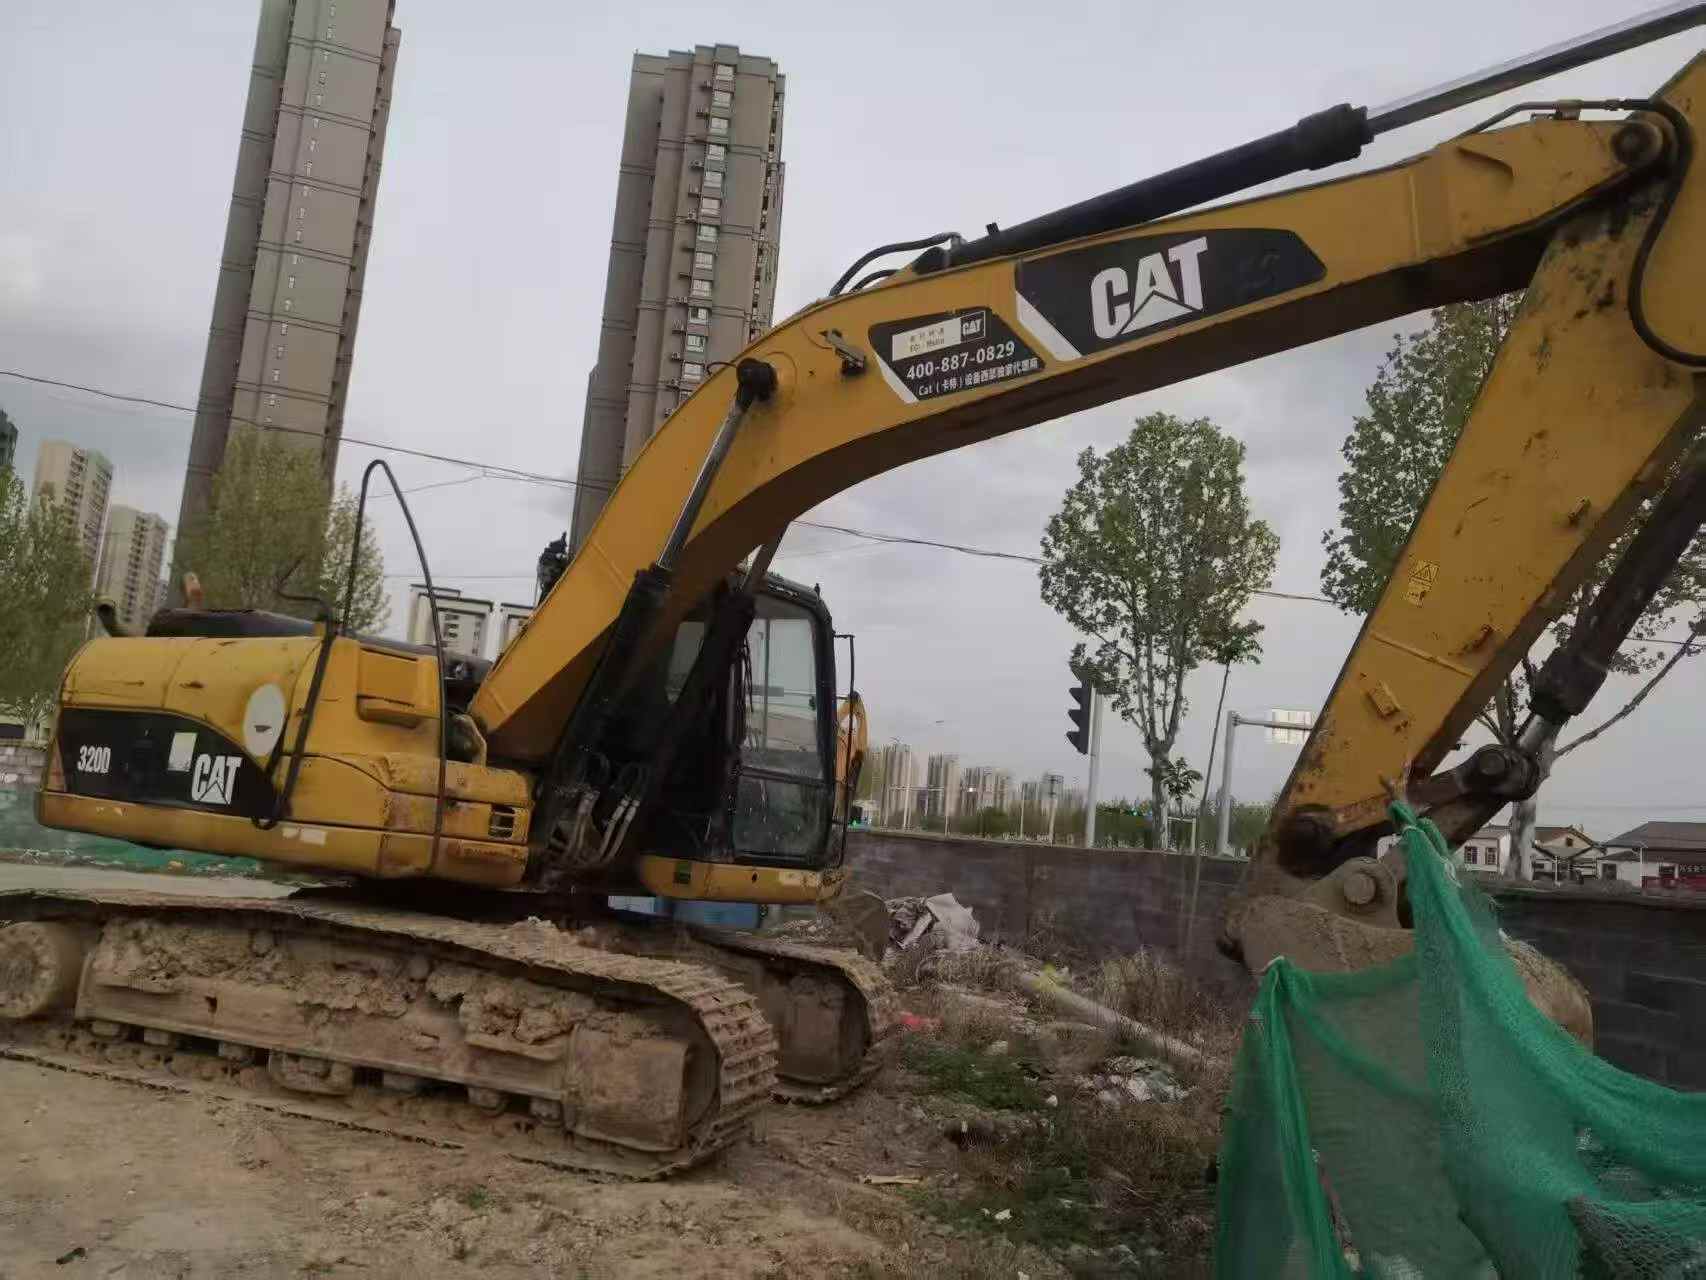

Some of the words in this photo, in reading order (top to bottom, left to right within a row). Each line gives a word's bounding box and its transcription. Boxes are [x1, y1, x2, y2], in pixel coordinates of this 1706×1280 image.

[1091, 236, 1207, 339] CAT
[961, 319, 983, 336] CAT
[906, 340, 1015, 379] 400-887-0829
[77, 745, 111, 774] 320D
[191, 753, 242, 805] CAT
